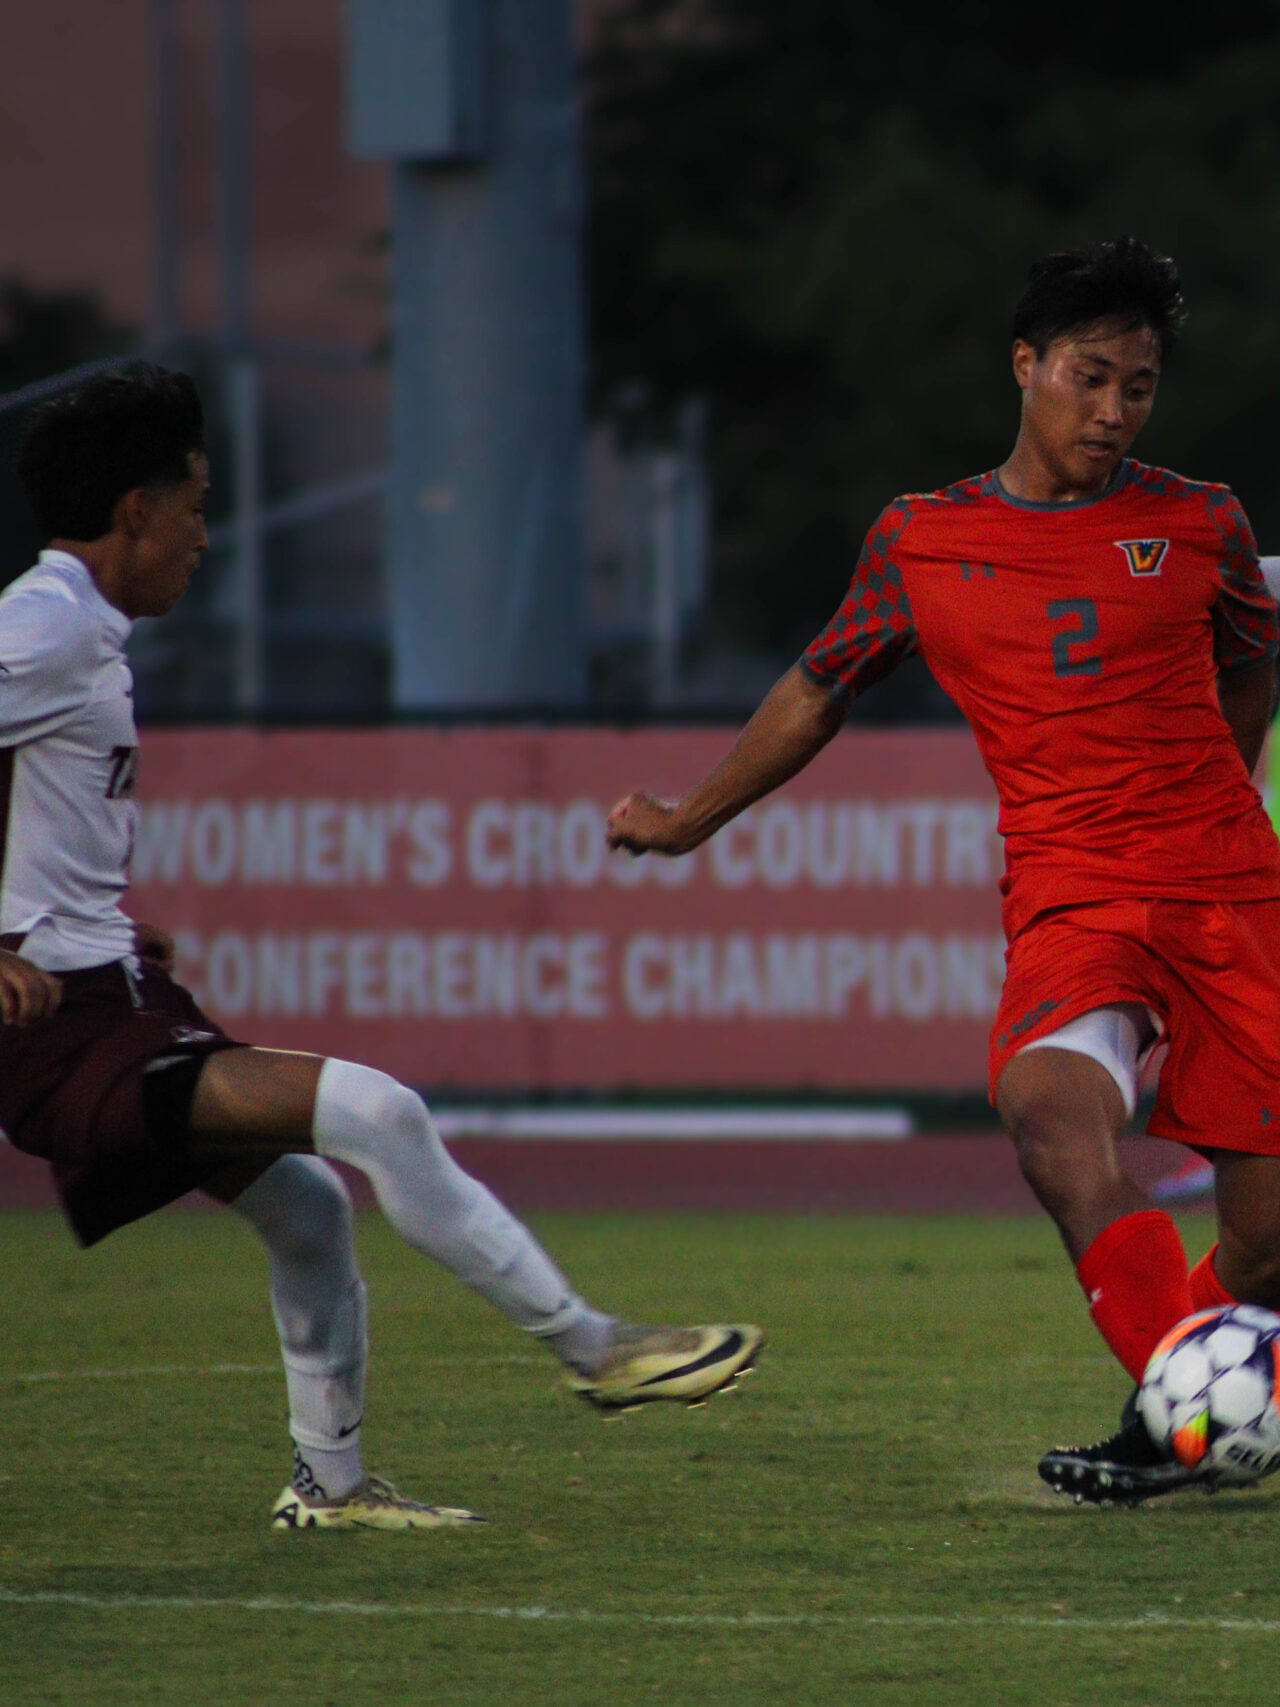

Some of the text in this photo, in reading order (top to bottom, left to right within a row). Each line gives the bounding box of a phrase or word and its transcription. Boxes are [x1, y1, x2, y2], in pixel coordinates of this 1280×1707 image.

[1046, 597, 1102, 679] 2
[134, 799, 449, 886] WOMEN'S
[713, 799, 1003, 887] COUNTR
[626, 933, 1006, 1019] CHAMPION
